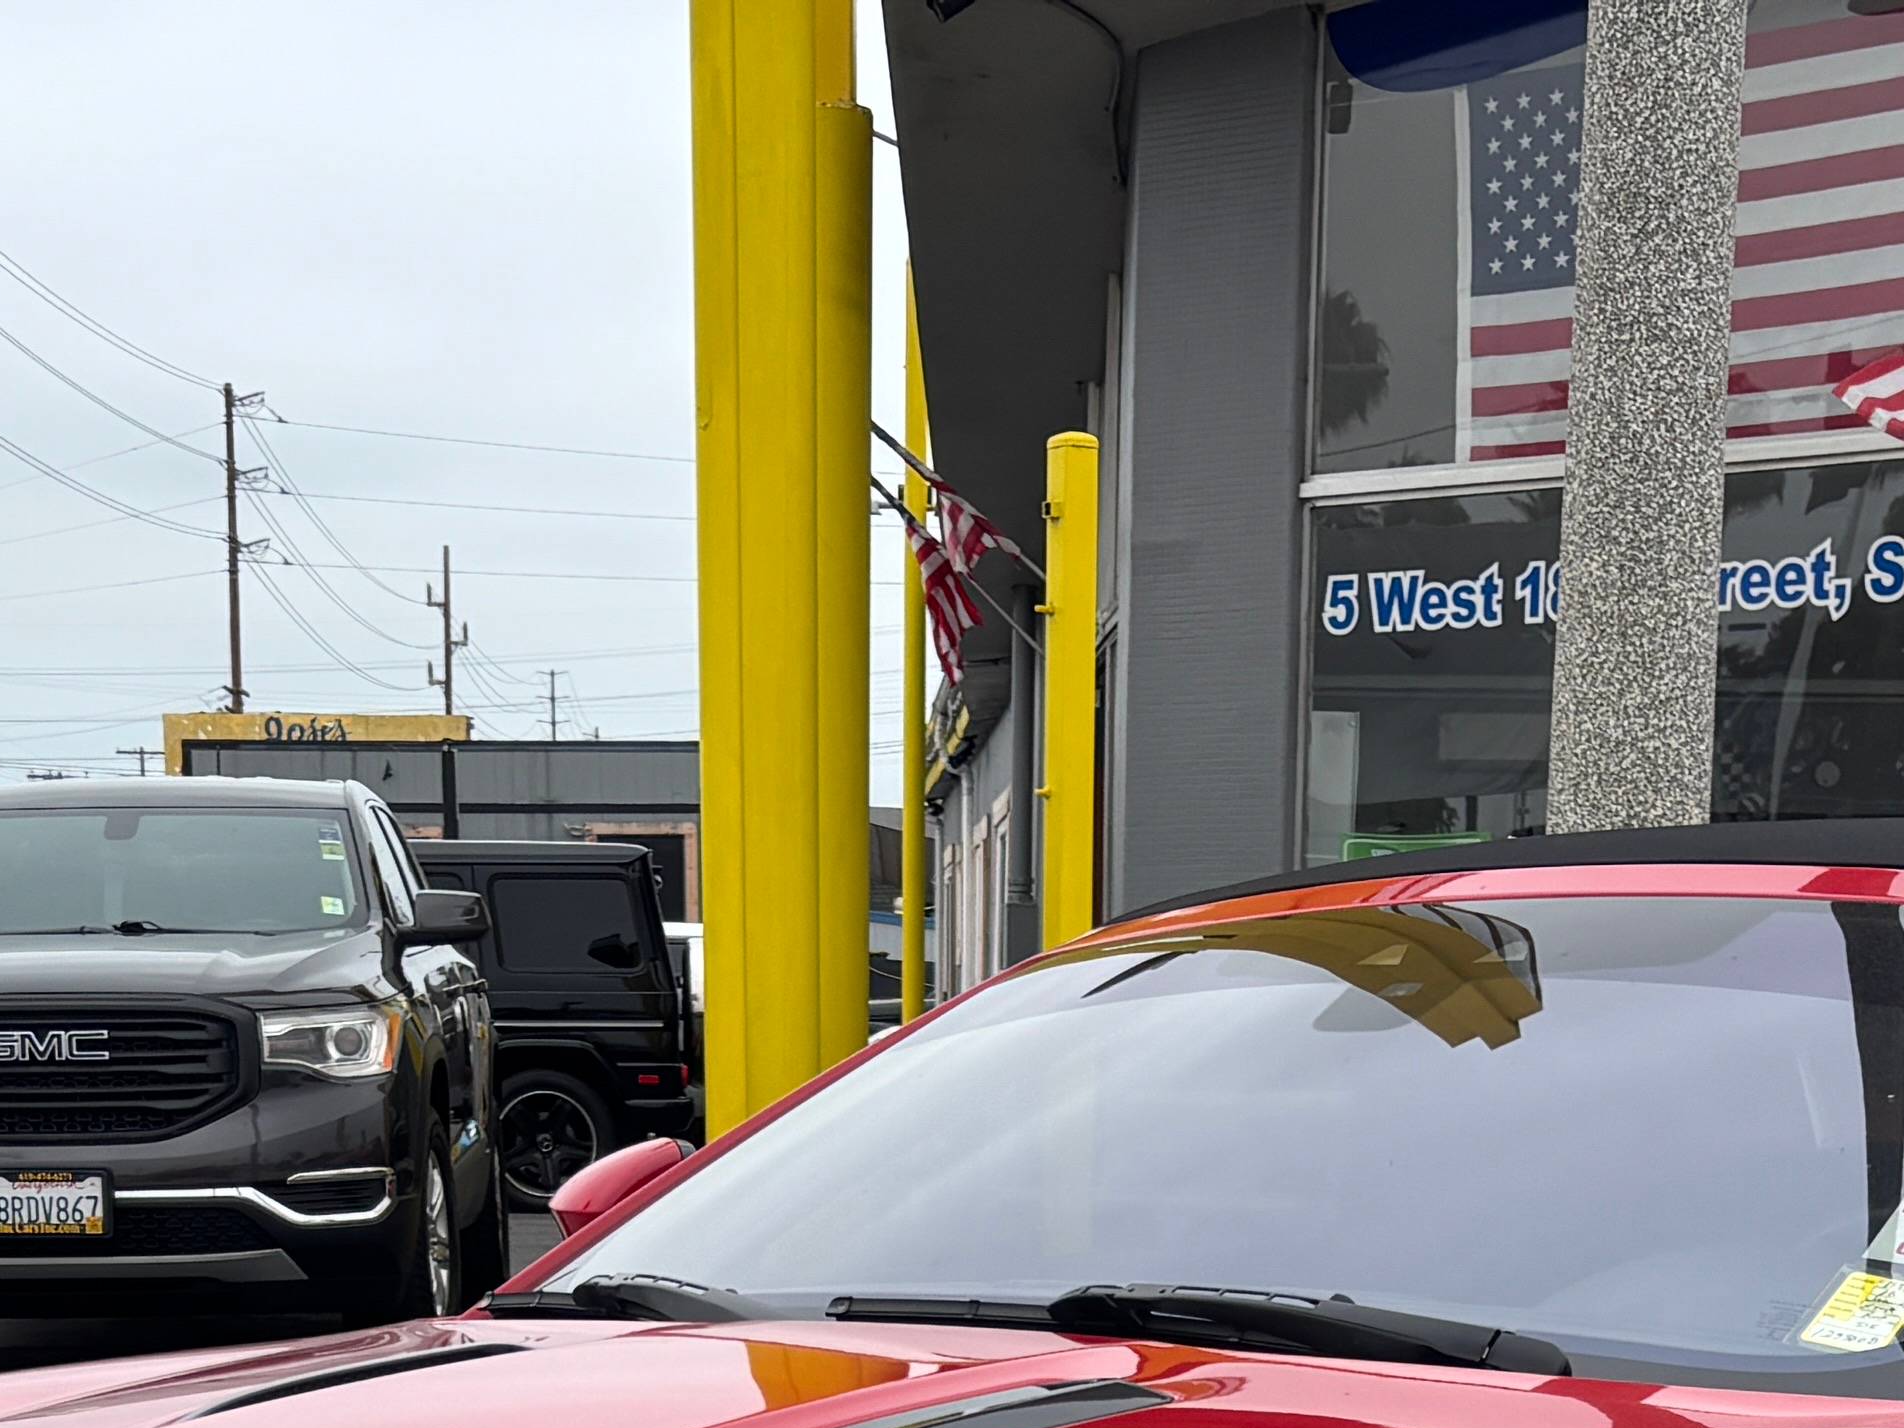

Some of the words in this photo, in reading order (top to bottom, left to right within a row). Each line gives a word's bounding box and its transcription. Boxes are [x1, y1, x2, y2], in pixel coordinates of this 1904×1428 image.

[1322, 574, 1359, 635] 5
[1368, 561, 1503, 633] West
[1718, 537, 1851, 621] reet,
